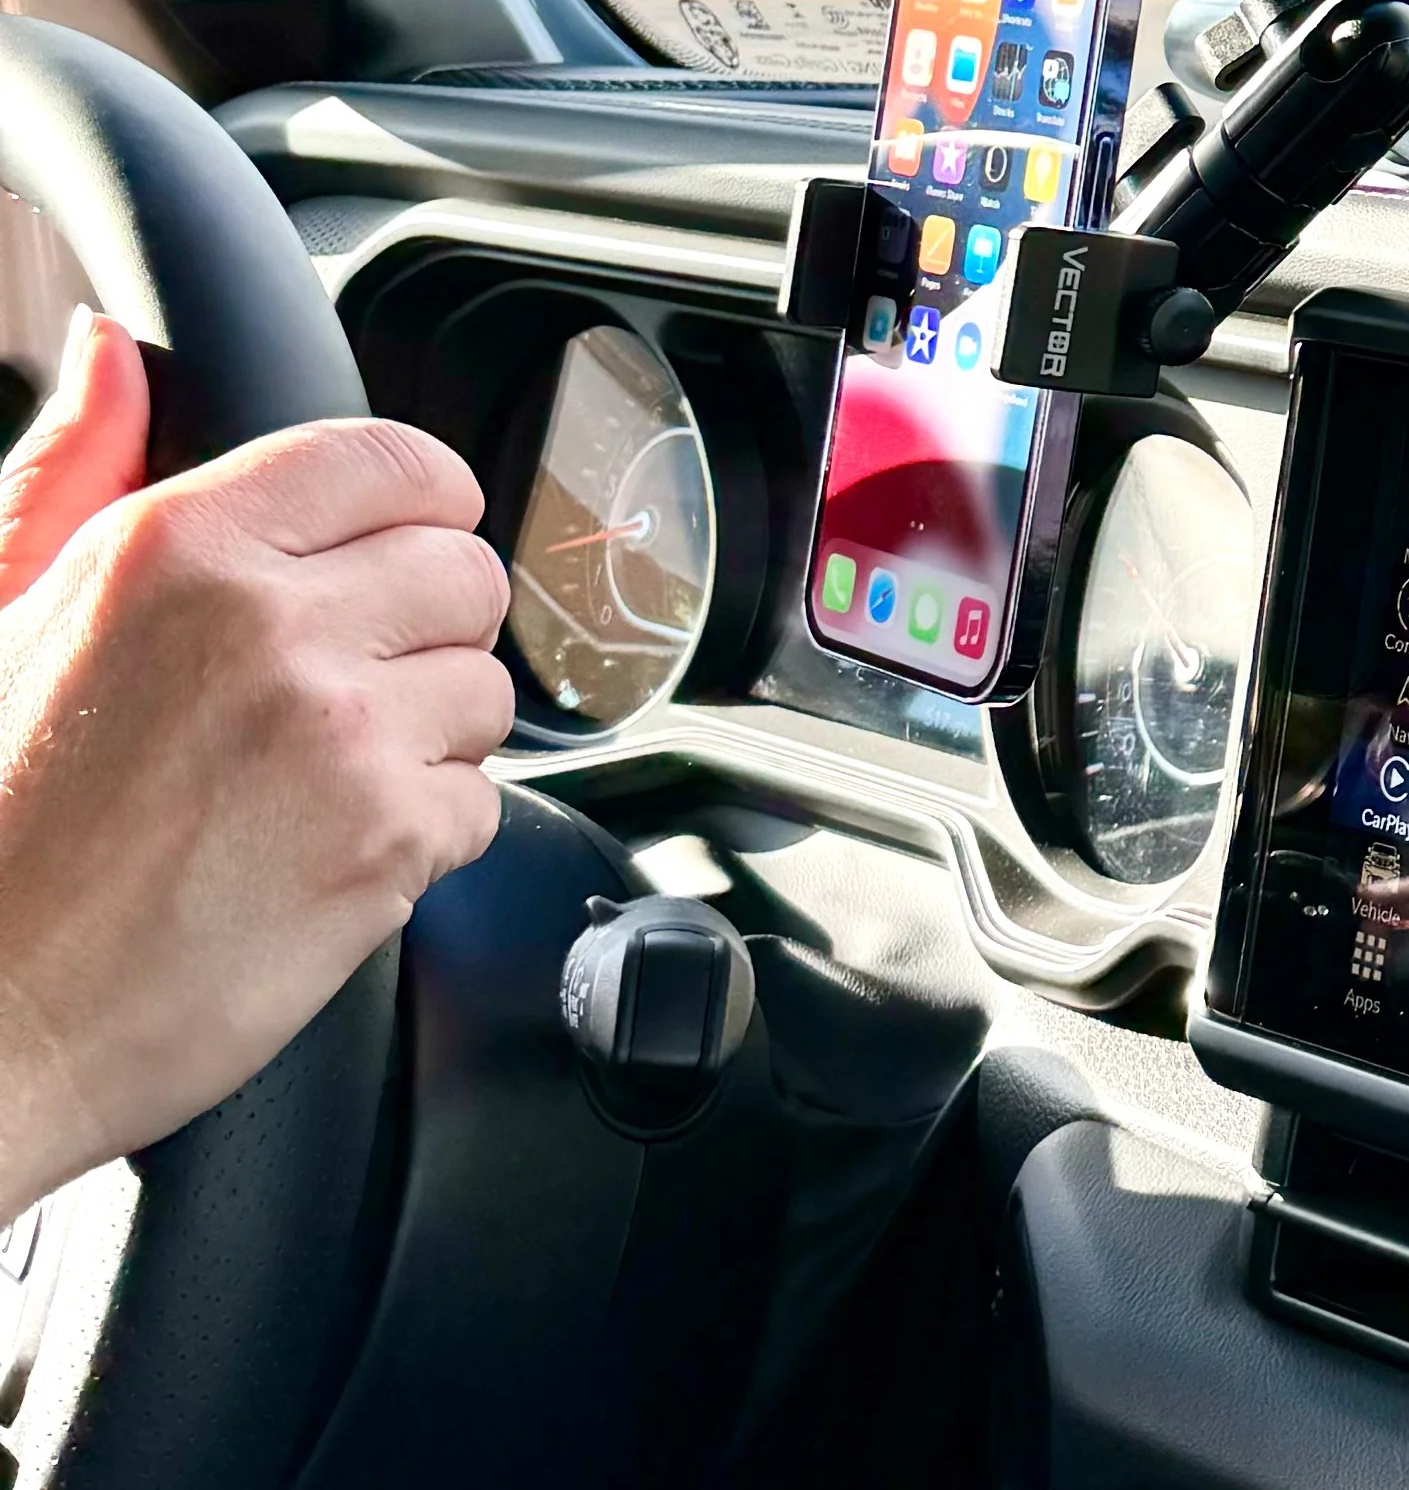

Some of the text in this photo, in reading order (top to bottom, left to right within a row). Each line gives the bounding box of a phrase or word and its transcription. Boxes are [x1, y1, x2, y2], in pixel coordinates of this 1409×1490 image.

[1039, 246, 1089, 377] VECTOR
[1350, 895, 1402, 927] Vehicle
[1343, 988, 1382, 1014] Apps
